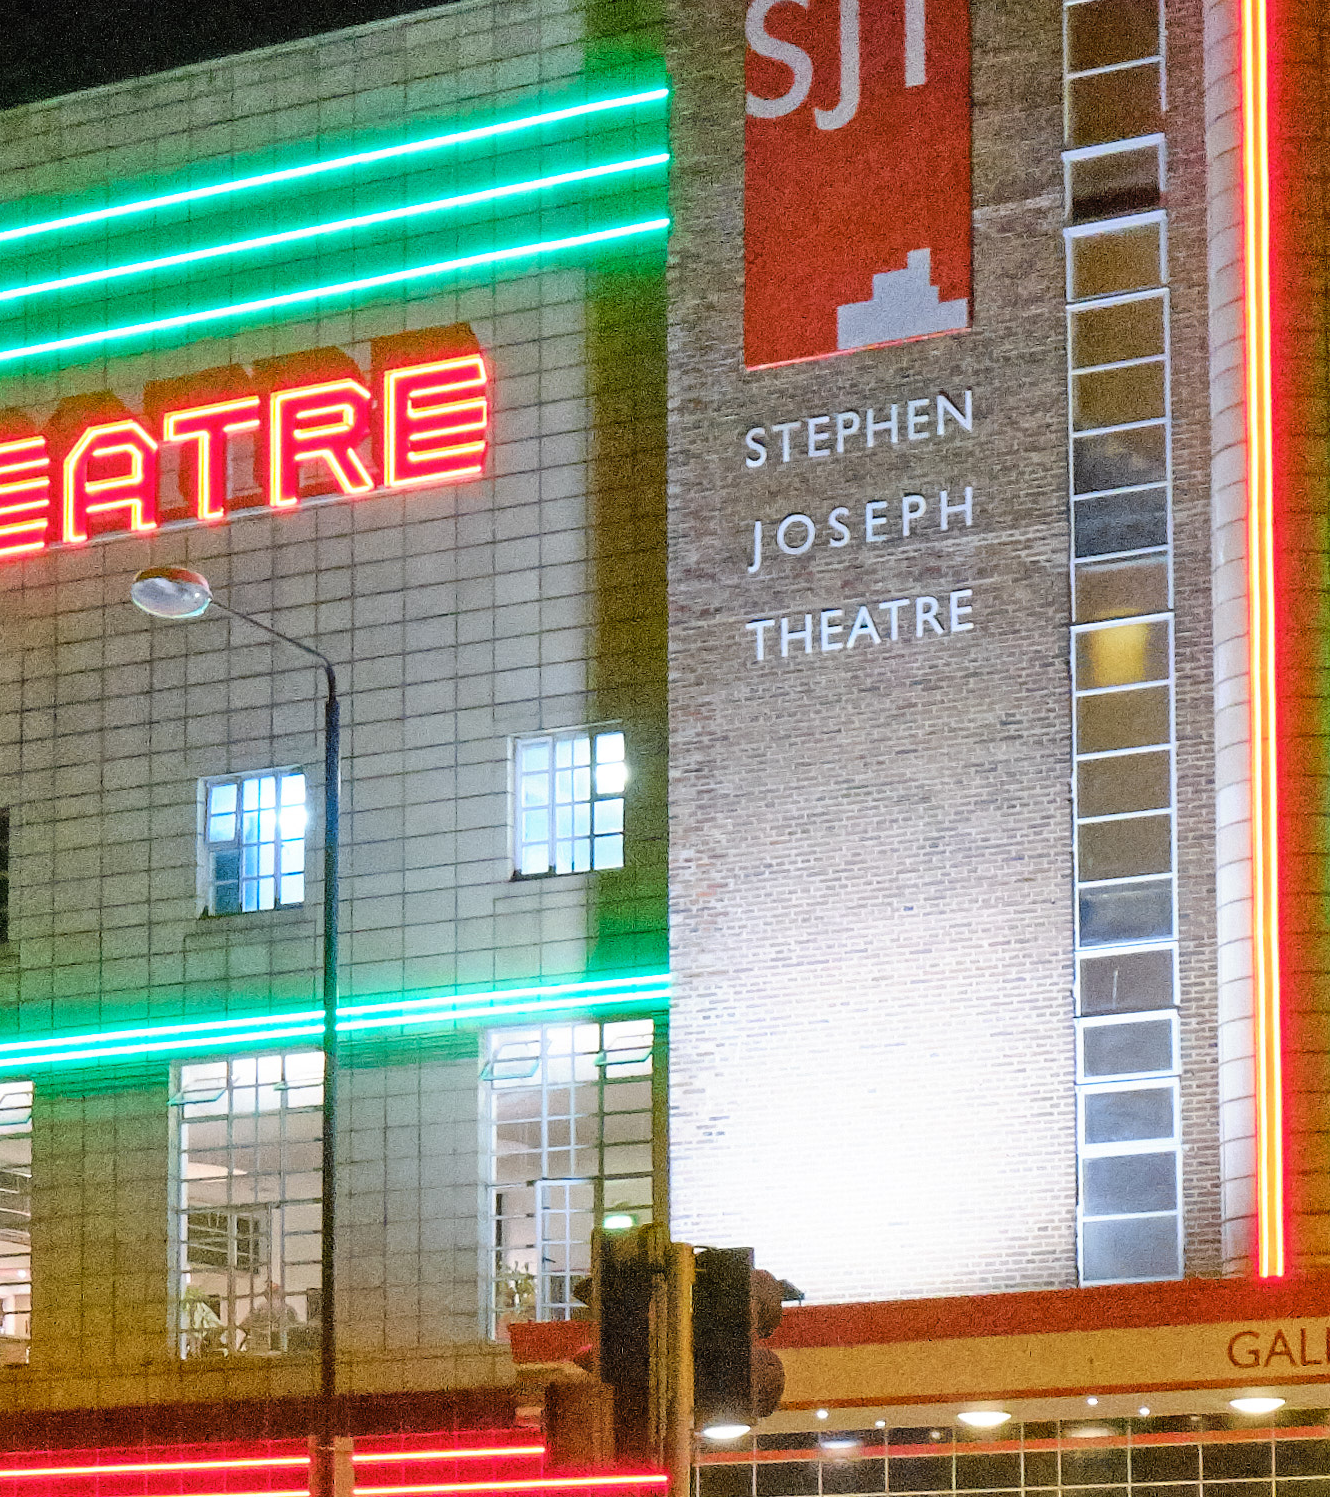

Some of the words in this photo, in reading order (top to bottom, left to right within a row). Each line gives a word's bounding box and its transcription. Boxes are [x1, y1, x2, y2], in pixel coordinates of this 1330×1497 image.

[745, 389, 974, 469] STEPHEN
[748, 486, 974, 574] JOSEPH
[746, 588, 974, 662] THEATRE
